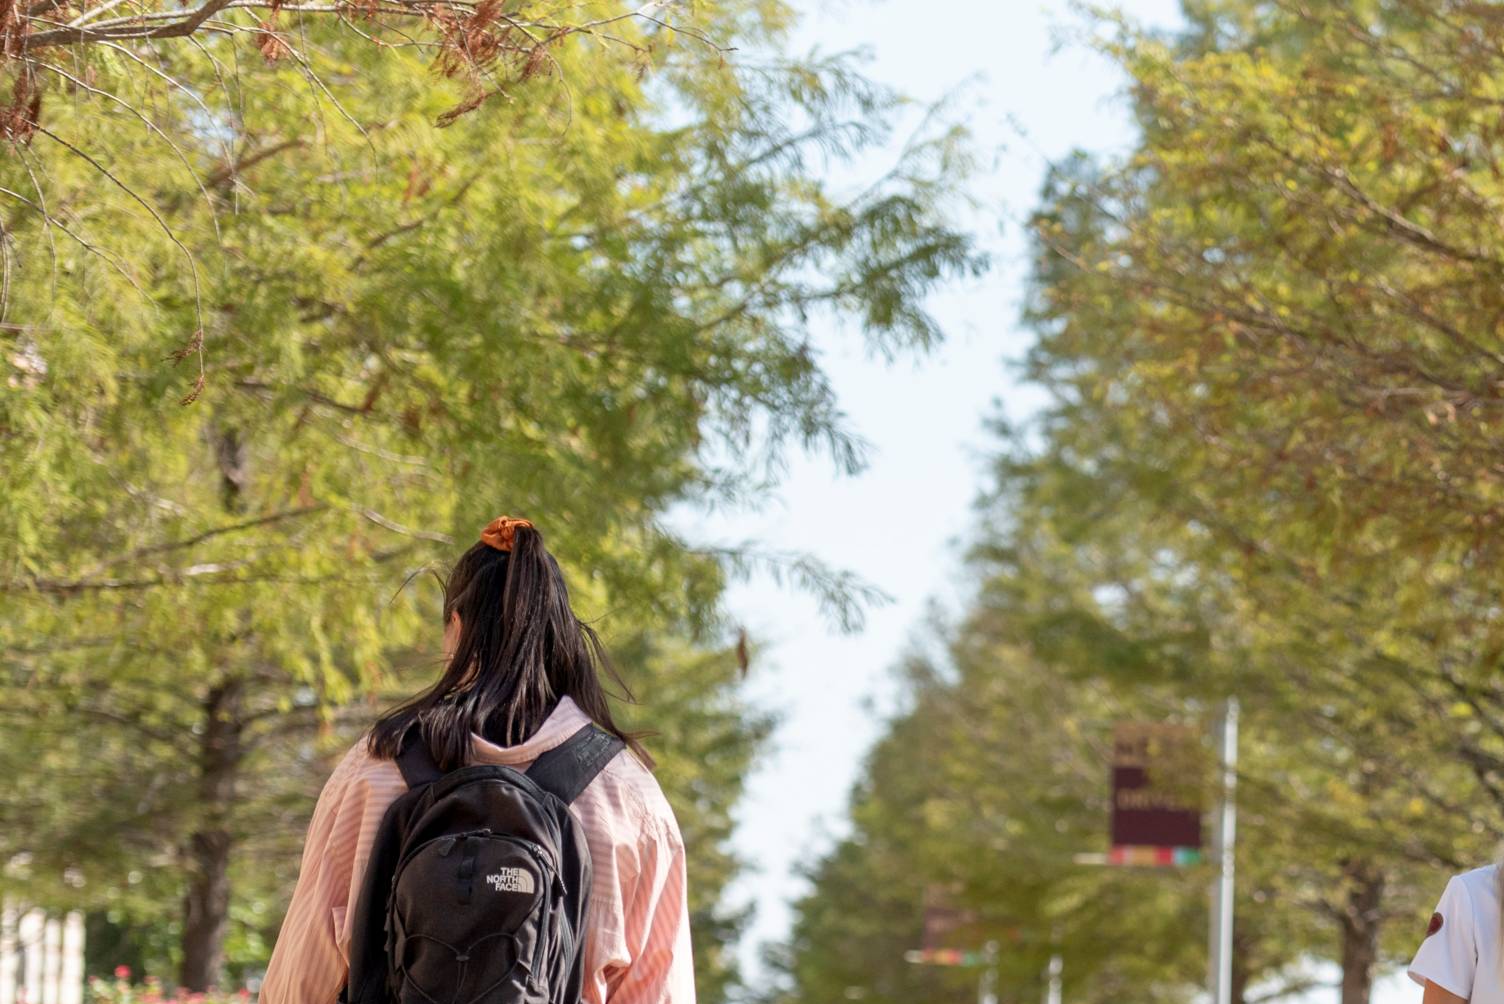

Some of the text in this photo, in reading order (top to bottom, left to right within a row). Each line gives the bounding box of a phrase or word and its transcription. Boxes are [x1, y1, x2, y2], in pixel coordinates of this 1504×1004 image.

[501, 867, 519, 876] THE
[486, 875, 519, 885] NORTH
[495, 883, 519, 892] FACE
